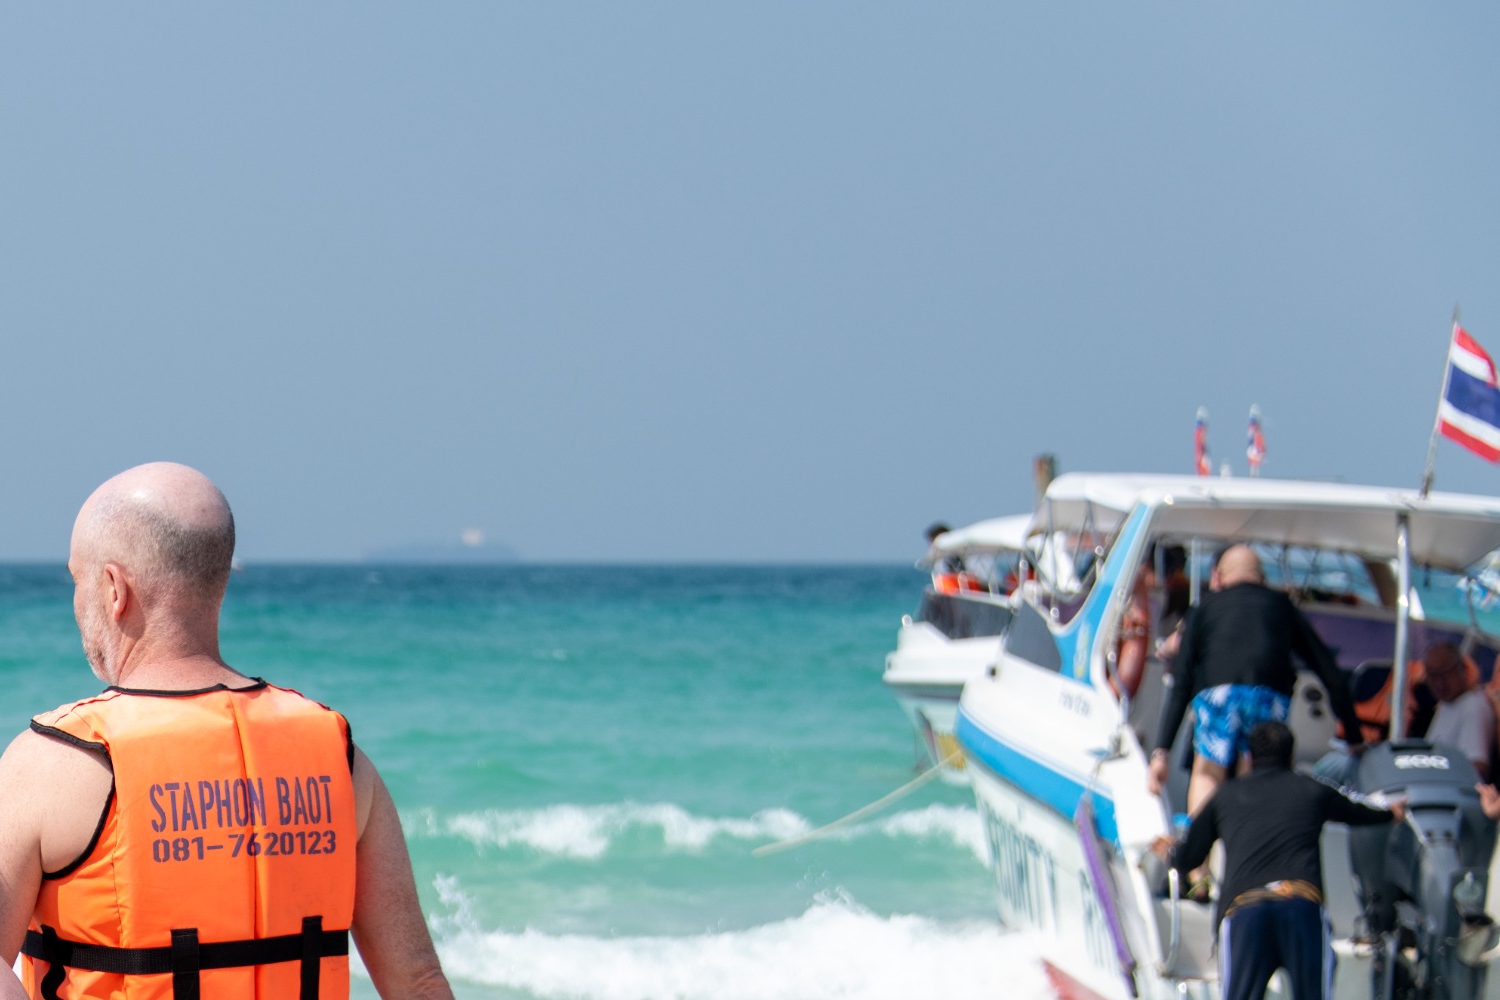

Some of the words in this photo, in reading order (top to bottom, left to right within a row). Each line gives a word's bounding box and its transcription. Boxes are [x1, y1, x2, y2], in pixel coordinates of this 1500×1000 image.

[150, 777, 267, 833] STAPHON
[275, 775, 332, 826] BAOT
[152, 830, 337, 863] 081-7620123
